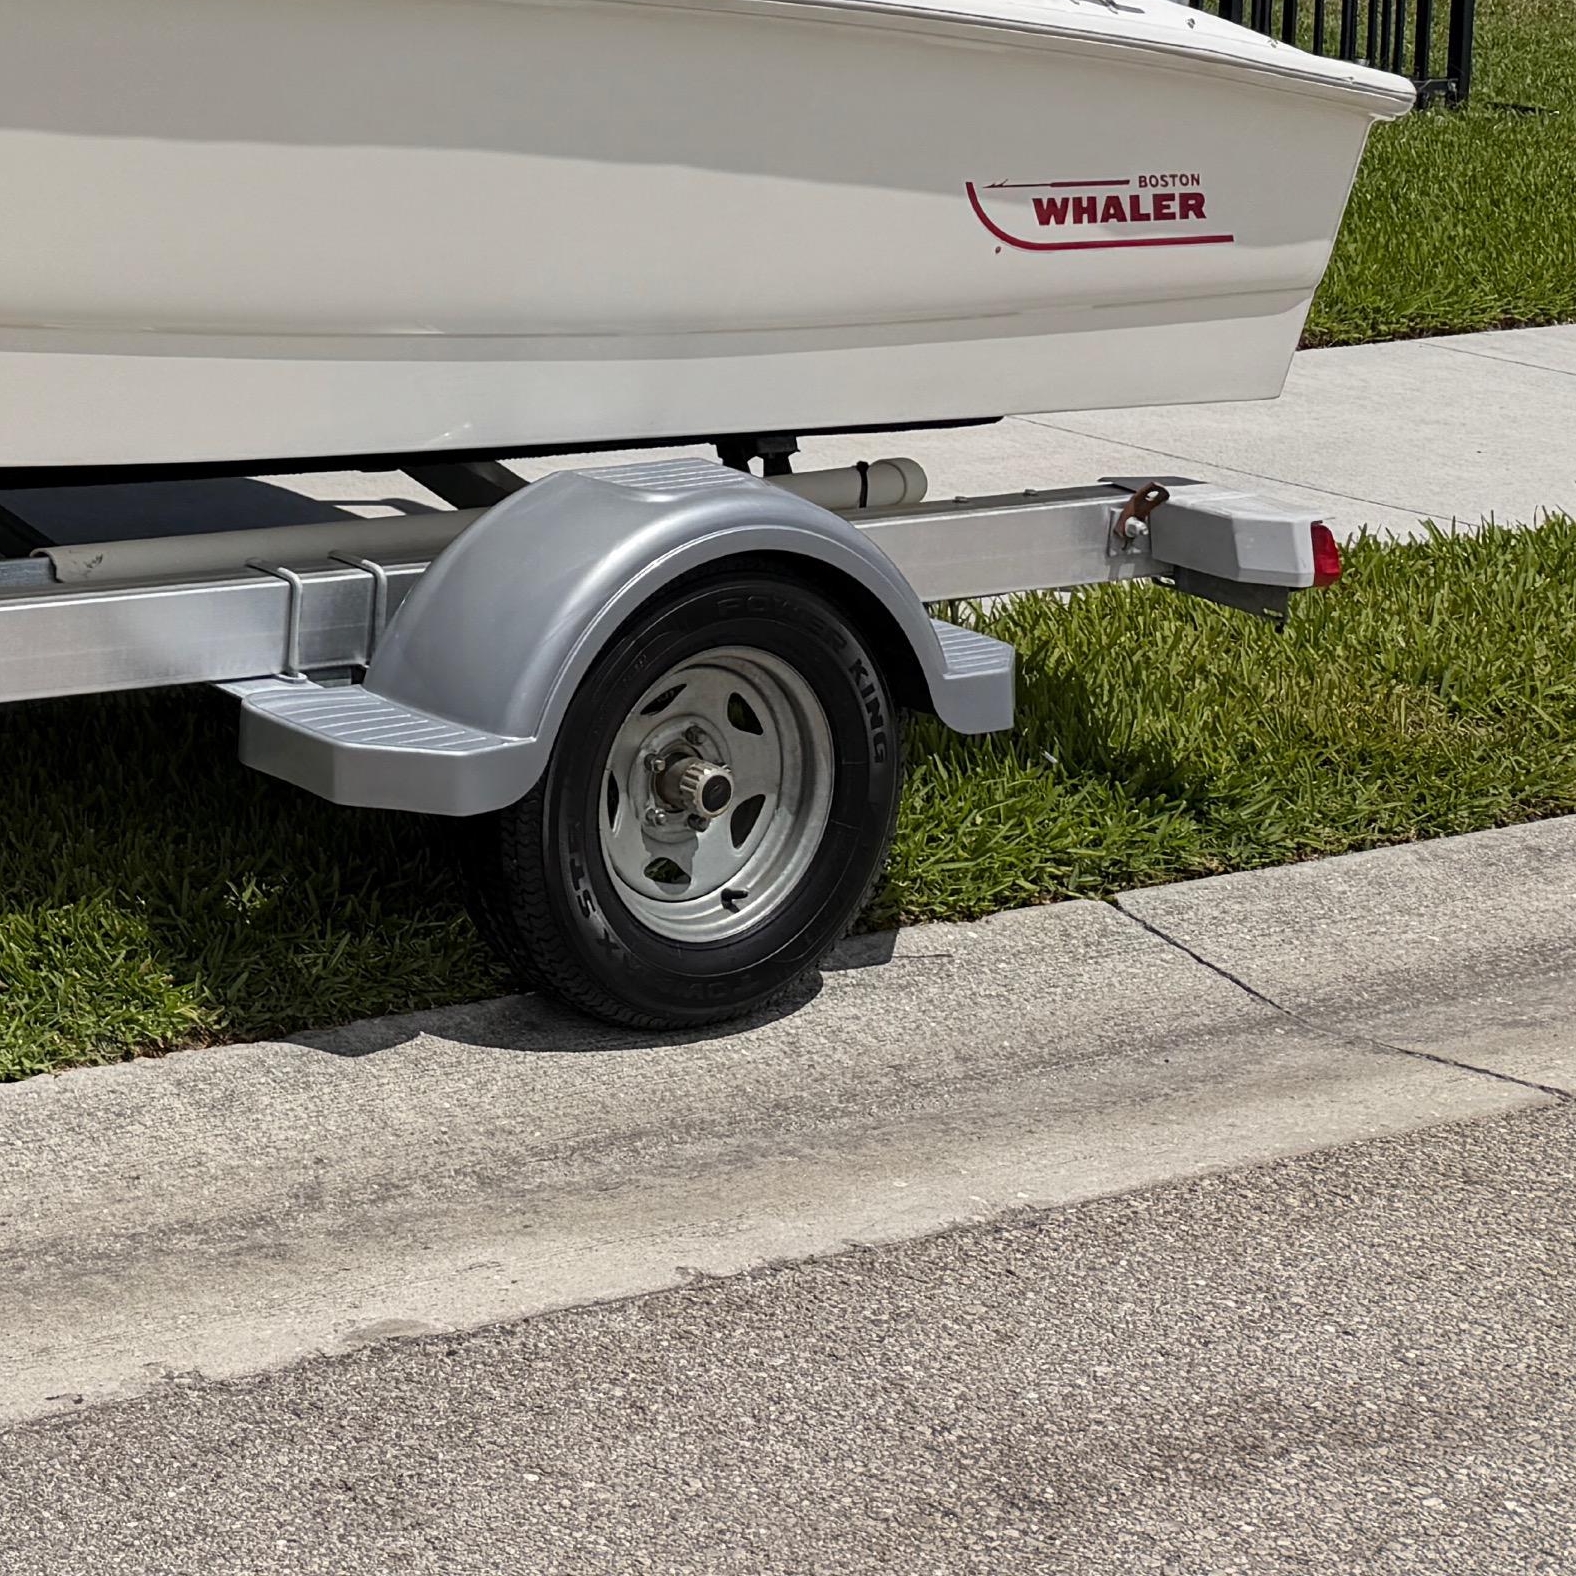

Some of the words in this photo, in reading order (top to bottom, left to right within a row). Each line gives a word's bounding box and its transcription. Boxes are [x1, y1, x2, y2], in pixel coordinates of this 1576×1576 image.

[1138, 173, 1201, 189] BOSTON
[1031, 192, 1207, 226] WHALER
[849, 658, 888, 765] KING
